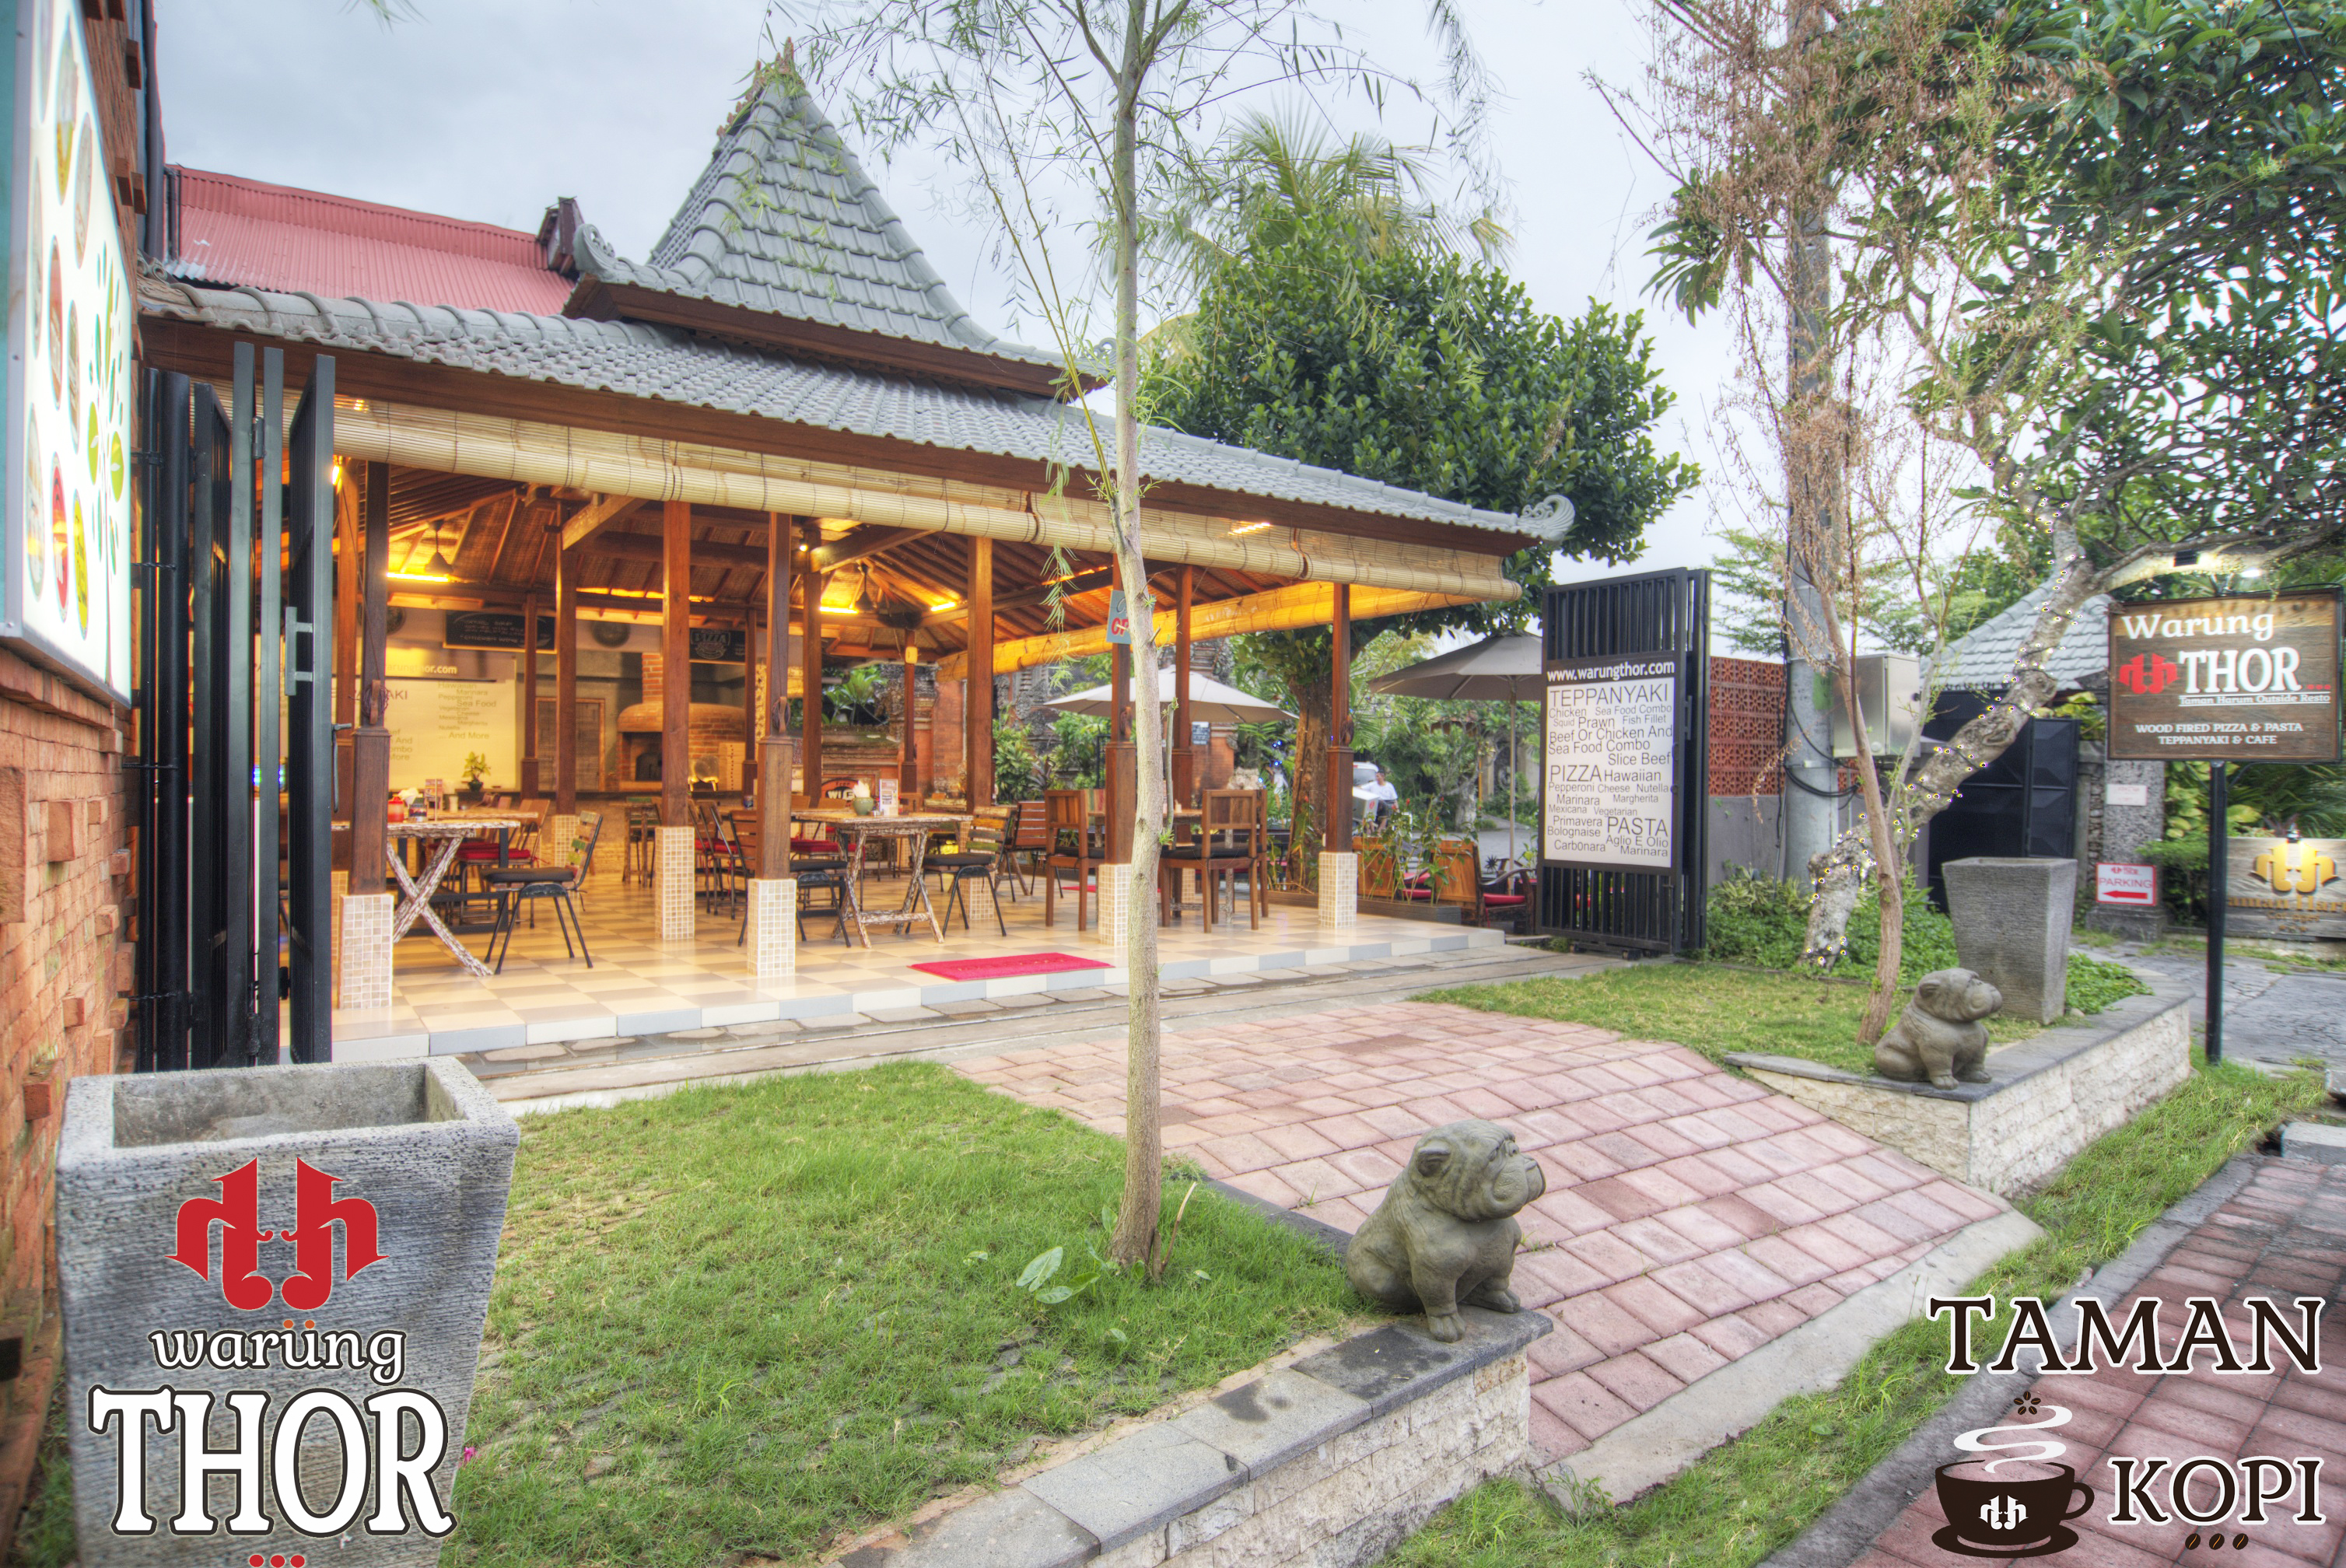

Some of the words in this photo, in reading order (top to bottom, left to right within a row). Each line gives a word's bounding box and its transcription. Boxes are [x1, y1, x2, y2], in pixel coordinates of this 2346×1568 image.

[1546, 661, 1675, 682] www.warungthor.com
[2178, 646, 2302, 694] THOR
[1549, 684, 1668, 707] TEPPANYAKI
[2180, 697, 2215, 705] Taman
[2217, 695, 2253, 704] Harum
[2256, 694, 2297, 703] Outside
[2300, 693, 2330, 702] Resto
[1549, 708, 1587, 719] Chicken
[1595, 706, 1612, 716] Sea
[1615, 705, 1637, 715] Food
[1639, 704, 1672, 714] Combo
[1553, 718, 1575, 728] Squid
[1578, 716, 1615, 729] Prawn
[1623, 715, 1641, 725] Fish
[1644, 714, 1666, 723] Fillet
[2135, 725, 2173, 733] WOOD
[2176, 723, 2211, 733] FIRED
[2213, 723, 2248, 733] PIZZA
[2250, 723, 2261, 732] &
[2264, 723, 2304, 732] PASTA
[1549, 730, 1574, 744] Beef
[1578, 729, 1592, 741] Or
[1596, 726, 1644, 740] Chicken
[1647, 724, 1672, 738] And
[2158, 735, 2229, 744] TEPPANYAKI
[2232, 735, 2243, 744] &
[2245, 735, 2278, 744] CAFE
[1549, 742, 1570, 754] Sea
[1574, 740, 1602, 754] Food
[1606, 738, 1651, 752] Combo
[1608, 753, 1637, 765] Slice
[1641, 751, 1671, 765] Beef
[1550, 765, 1602, 782] PIZZA
[1604, 768, 1661, 782] Hawaiian
[1549, 782, 1595, 793] Pepperoni
[1597, 783, 1630, 793] Cheese
[1637, 783, 1669, 793] Nutella
[1556, 794, 1601, 806] Marinara
[1612, 794, 1659, 805] Margherita
[1549, 804, 1588, 814] Mexicana
[1594, 807, 1638, 817] Vegetarian
[1547, 826, 1601, 838] Bolognaise
[1553, 815, 1603, 827] Primavera
[1607, 817, 1668, 838] PASTA
[1605, 835, 1632, 847] Aglio
[1635, 836, 1643, 846] E
[1647, 836, 1668, 848] Olio
[1620, 845, 1668, 857] Marinara
[2099, 877, 2153, 888] PARKING
[2228, 897, 2289, 909] aman
